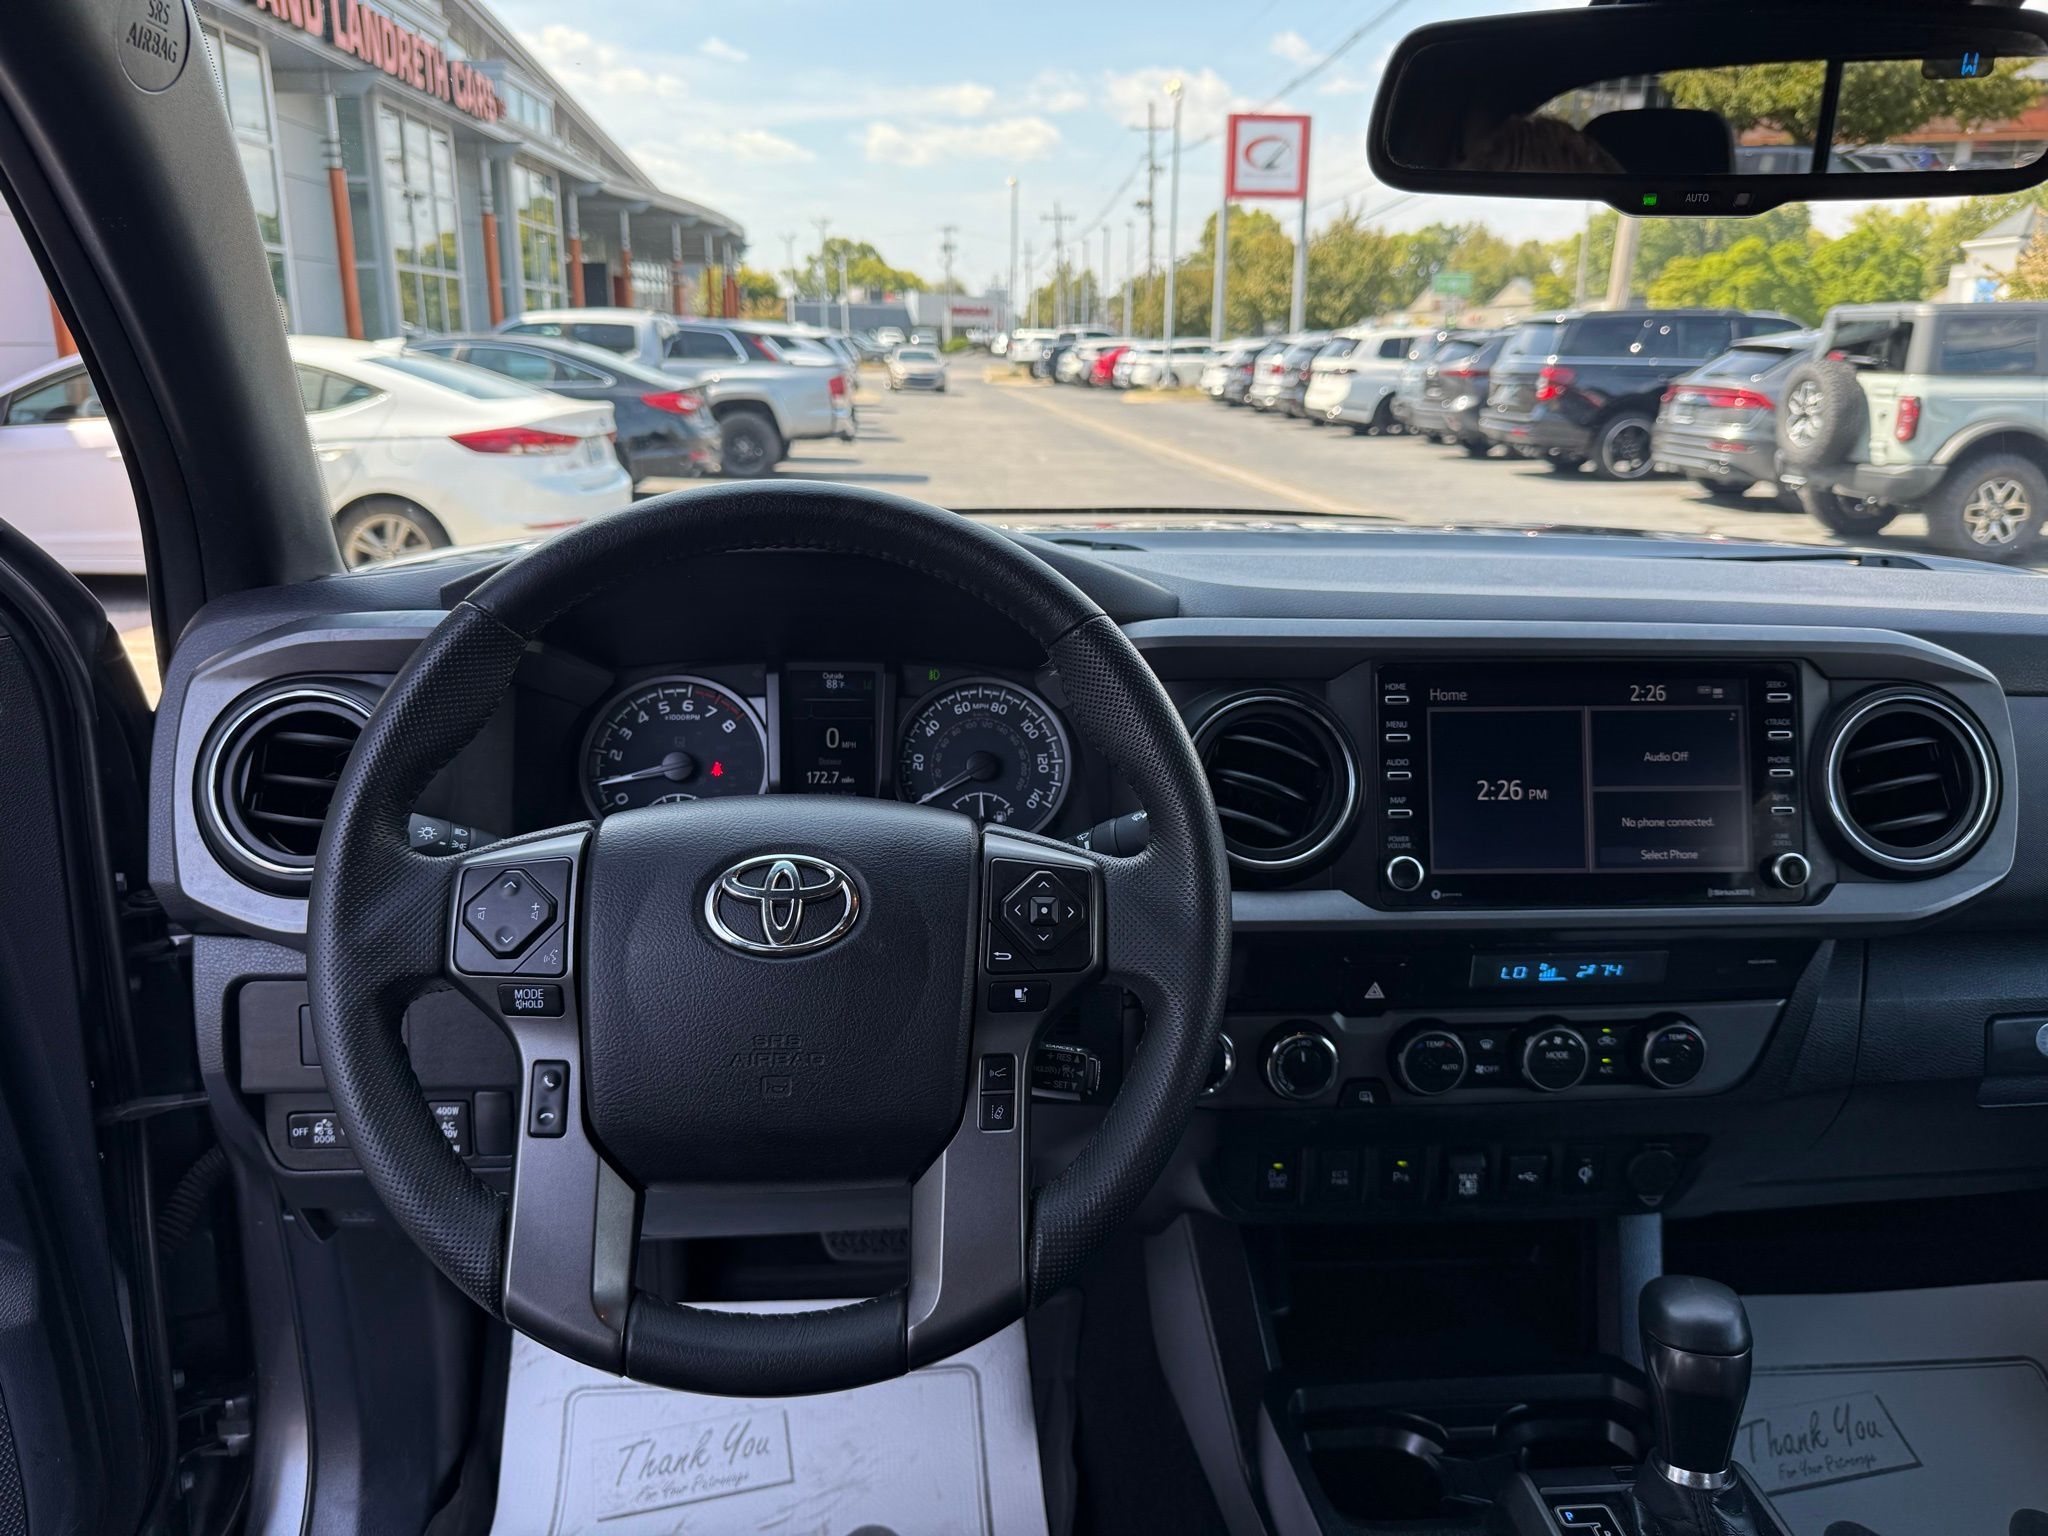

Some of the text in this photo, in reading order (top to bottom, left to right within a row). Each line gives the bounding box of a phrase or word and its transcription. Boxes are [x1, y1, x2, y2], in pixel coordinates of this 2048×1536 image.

[148, 0, 170, 25] SRS
[126, 22, 178, 63] AIRBAG
[330, 0, 450, 102] LANDRETH
[1685, 193, 1710, 203] AUTO
[1385, 682, 1407, 691] HOME
[1629, 684, 1666, 702] 2:26
[1429, 688, 1469, 701] Home
[658, 701, 670, 714] 5
[682, 700, 694, 712] 6
[705, 705, 718, 718] 7
[954, 702, 971, 715] 60
[990, 702, 1007, 715] 80
[638, 710, 649, 723] 4
[722, 719, 736, 733] 8
[925, 720, 940, 737] 40
[1020, 719, 1039, 739] 100
[1385, 720, 1408, 728] MENU
[619, 727, 632, 740] 3
[826, 727, 857, 749] 0 MPH
[609, 749, 623, 761] 2
[1643, 752, 1689, 762] Audio Off
[912, 753, 924, 771] 20
[1036, 753, 1049, 773] 120
[806, 771, 840, 784] 172.7
[1477, 779, 1548, 801] 2:26 PM
[615, 792, 629, 805] 0
[1026, 788, 1043, 809] 140
[1389, 796, 1407, 804] MAP
[1621, 817, 1715, 829] No phone connected.
[1641, 849, 1699, 860] Select Phone
[514, 988, 544, 999] MODE
[522, 1000, 544, 1009] HOLD
[1046, 1043, 1075, 1052] CANCEL
[1425, 1040, 1445, 1049] TEMP
[292, 1127, 309, 1137] OFF
[441, 1121, 456, 1130] AC
[313, 1135, 336, 1144] DOOR
[1740, 1402, 1883, 1463] Thank You
[616, 1418, 769, 1487] Thank You
[1564, 1511, 1574, 1522] P
